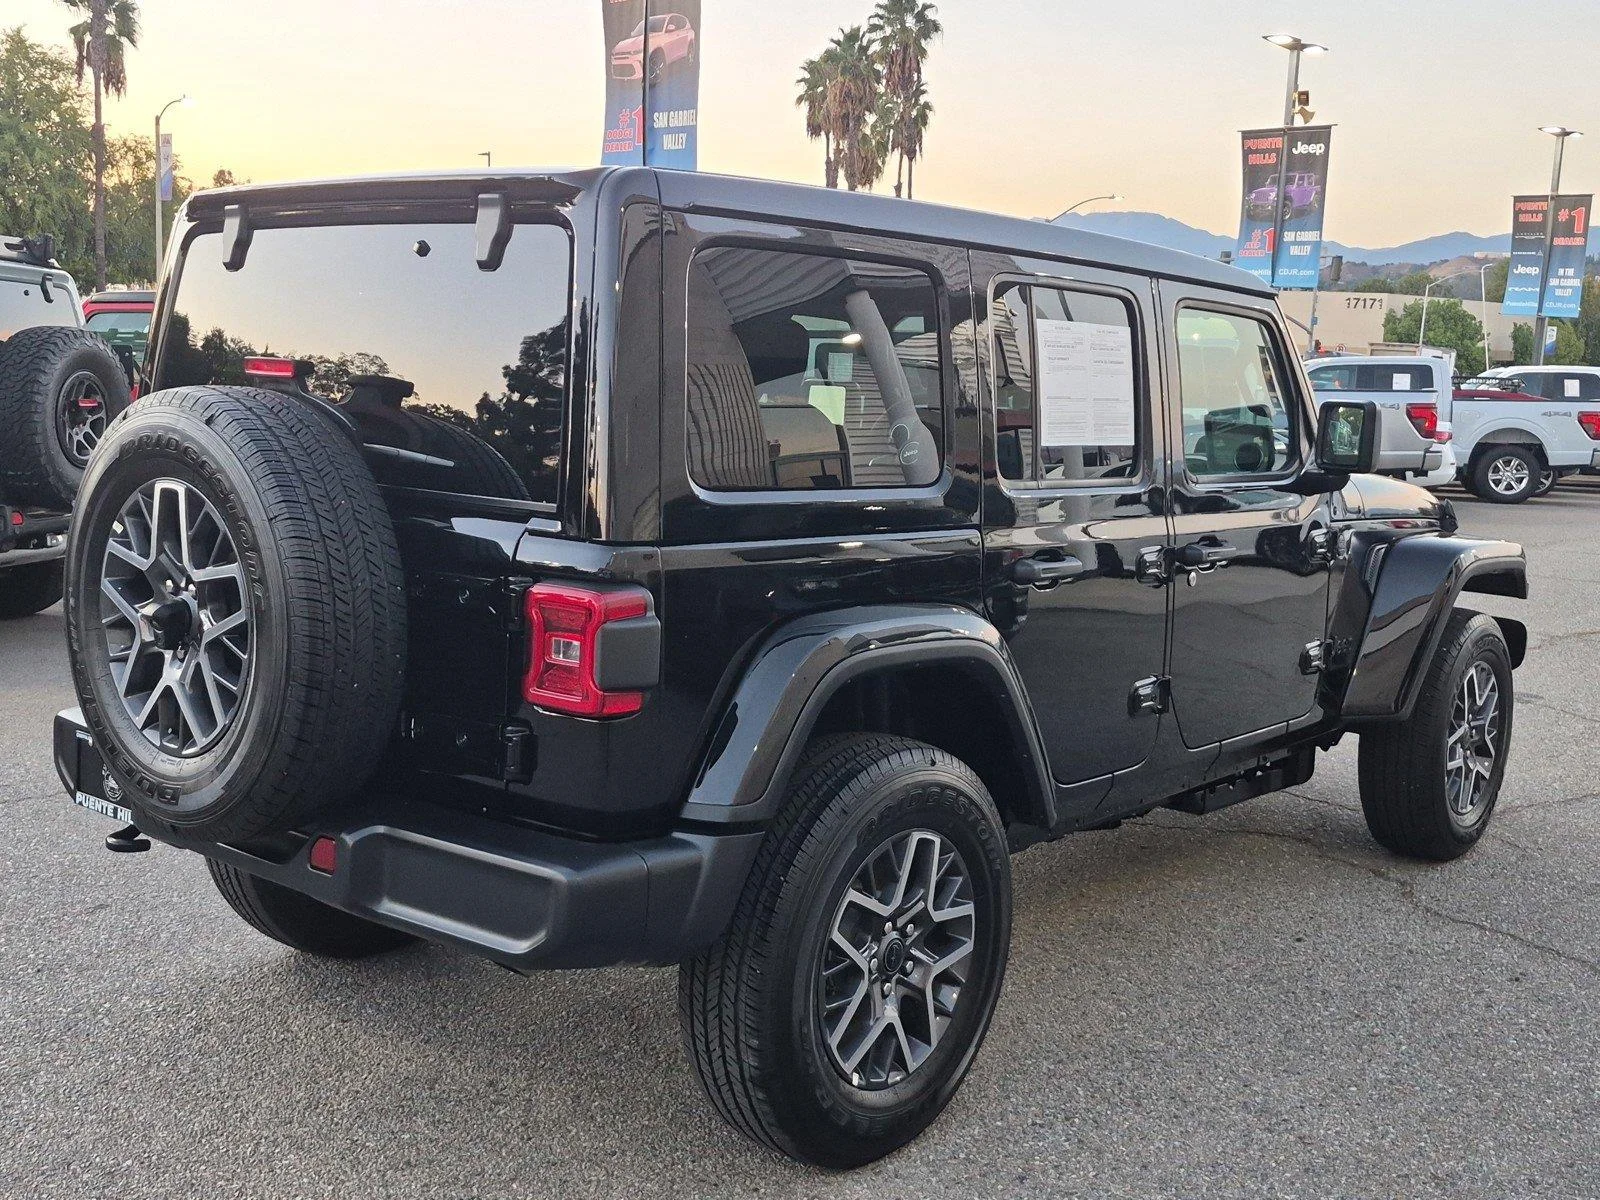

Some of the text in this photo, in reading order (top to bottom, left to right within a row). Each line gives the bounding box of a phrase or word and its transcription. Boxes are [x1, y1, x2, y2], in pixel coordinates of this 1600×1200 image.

[653, 109, 697, 129] SAN GABRIEL
[604, 140, 634, 152] DEALER
[663, 132, 687, 150] VALLEY
[1243, 137, 1283, 150] PUENTE
[1291, 141, 1326, 156] Jeep
[1248, 153, 1277, 165] HILLS
[1514, 201, 1548, 211] PUENTE
[1518, 213, 1543, 222] HILLS
[1557, 206, 1586, 234] #1
[1283, 230, 1321, 242] SAN GABRIEL
[1289, 245, 1312, 256] VALLEY
[1278, 268, 1315, 276] CDJR.com
[1512, 263, 1540, 276] Jeep
[1345, 297, 1383, 310] 17171
[75, 790, 134, 824] PUENTE HIL
